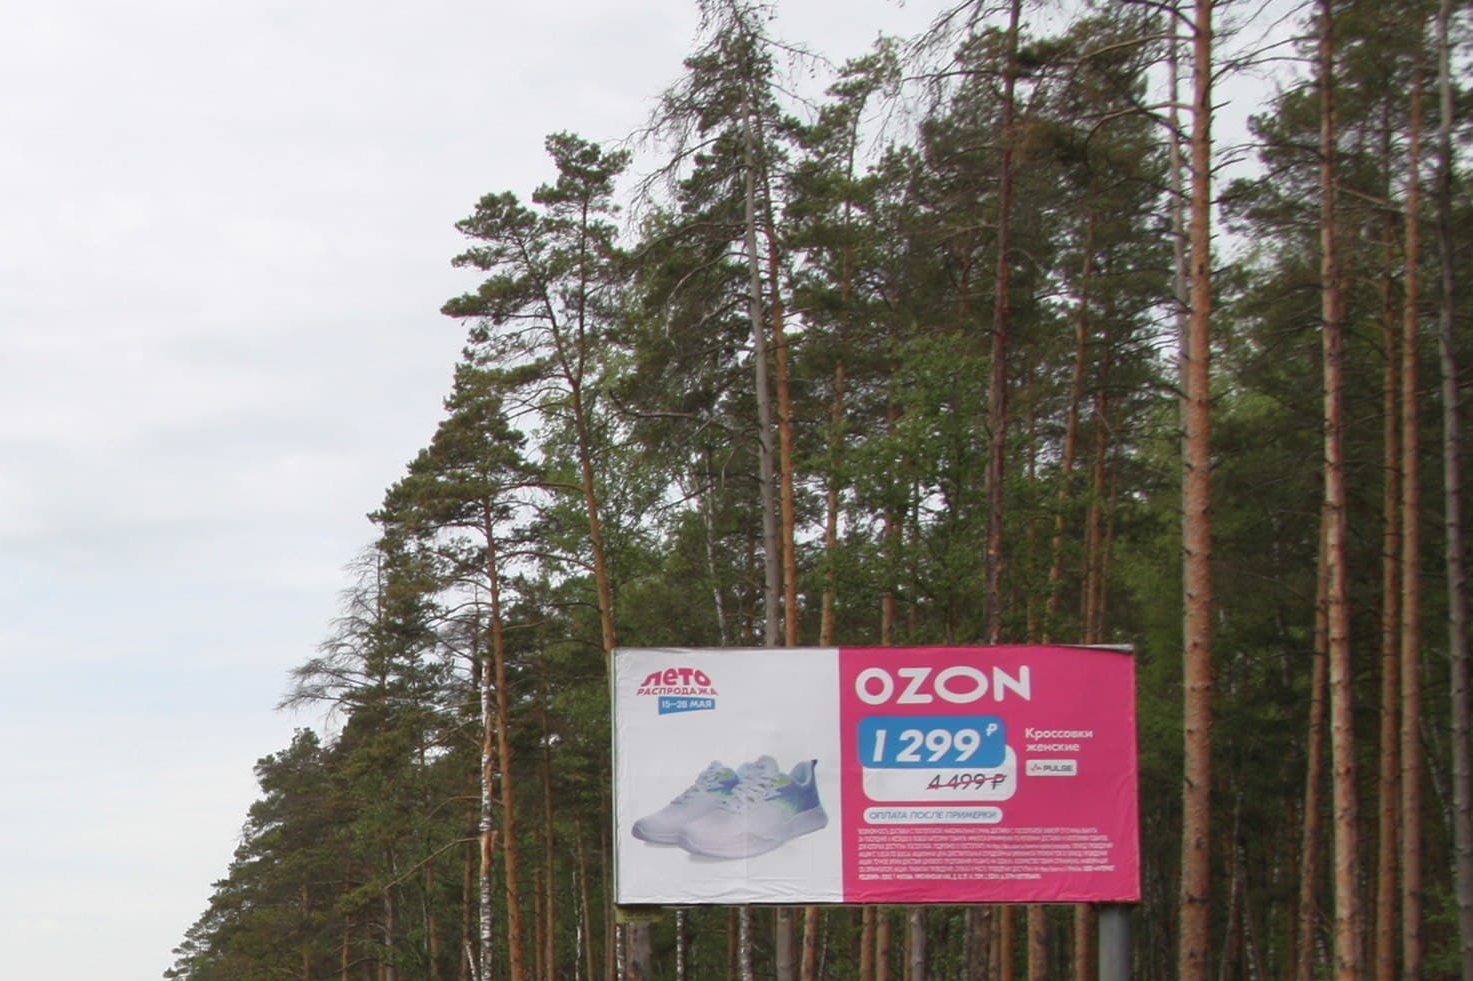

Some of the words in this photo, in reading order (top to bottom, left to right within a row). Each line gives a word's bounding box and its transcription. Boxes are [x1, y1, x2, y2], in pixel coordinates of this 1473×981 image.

[855, 665, 1031, 705] OZON
[636, 687, 718, 696] РАСПРОДАЖА
[690, 699, 712, 708] МАЯ
[1025, 728, 1093, 741] Кроссовки
[1026, 743, 1080, 752] женские
[870, 811, 907, 820] ОПЛАТА
[910, 811, 944, 819] ПОСЛЕ
[947, 811, 997, 819] ПРИМЕРКИ
